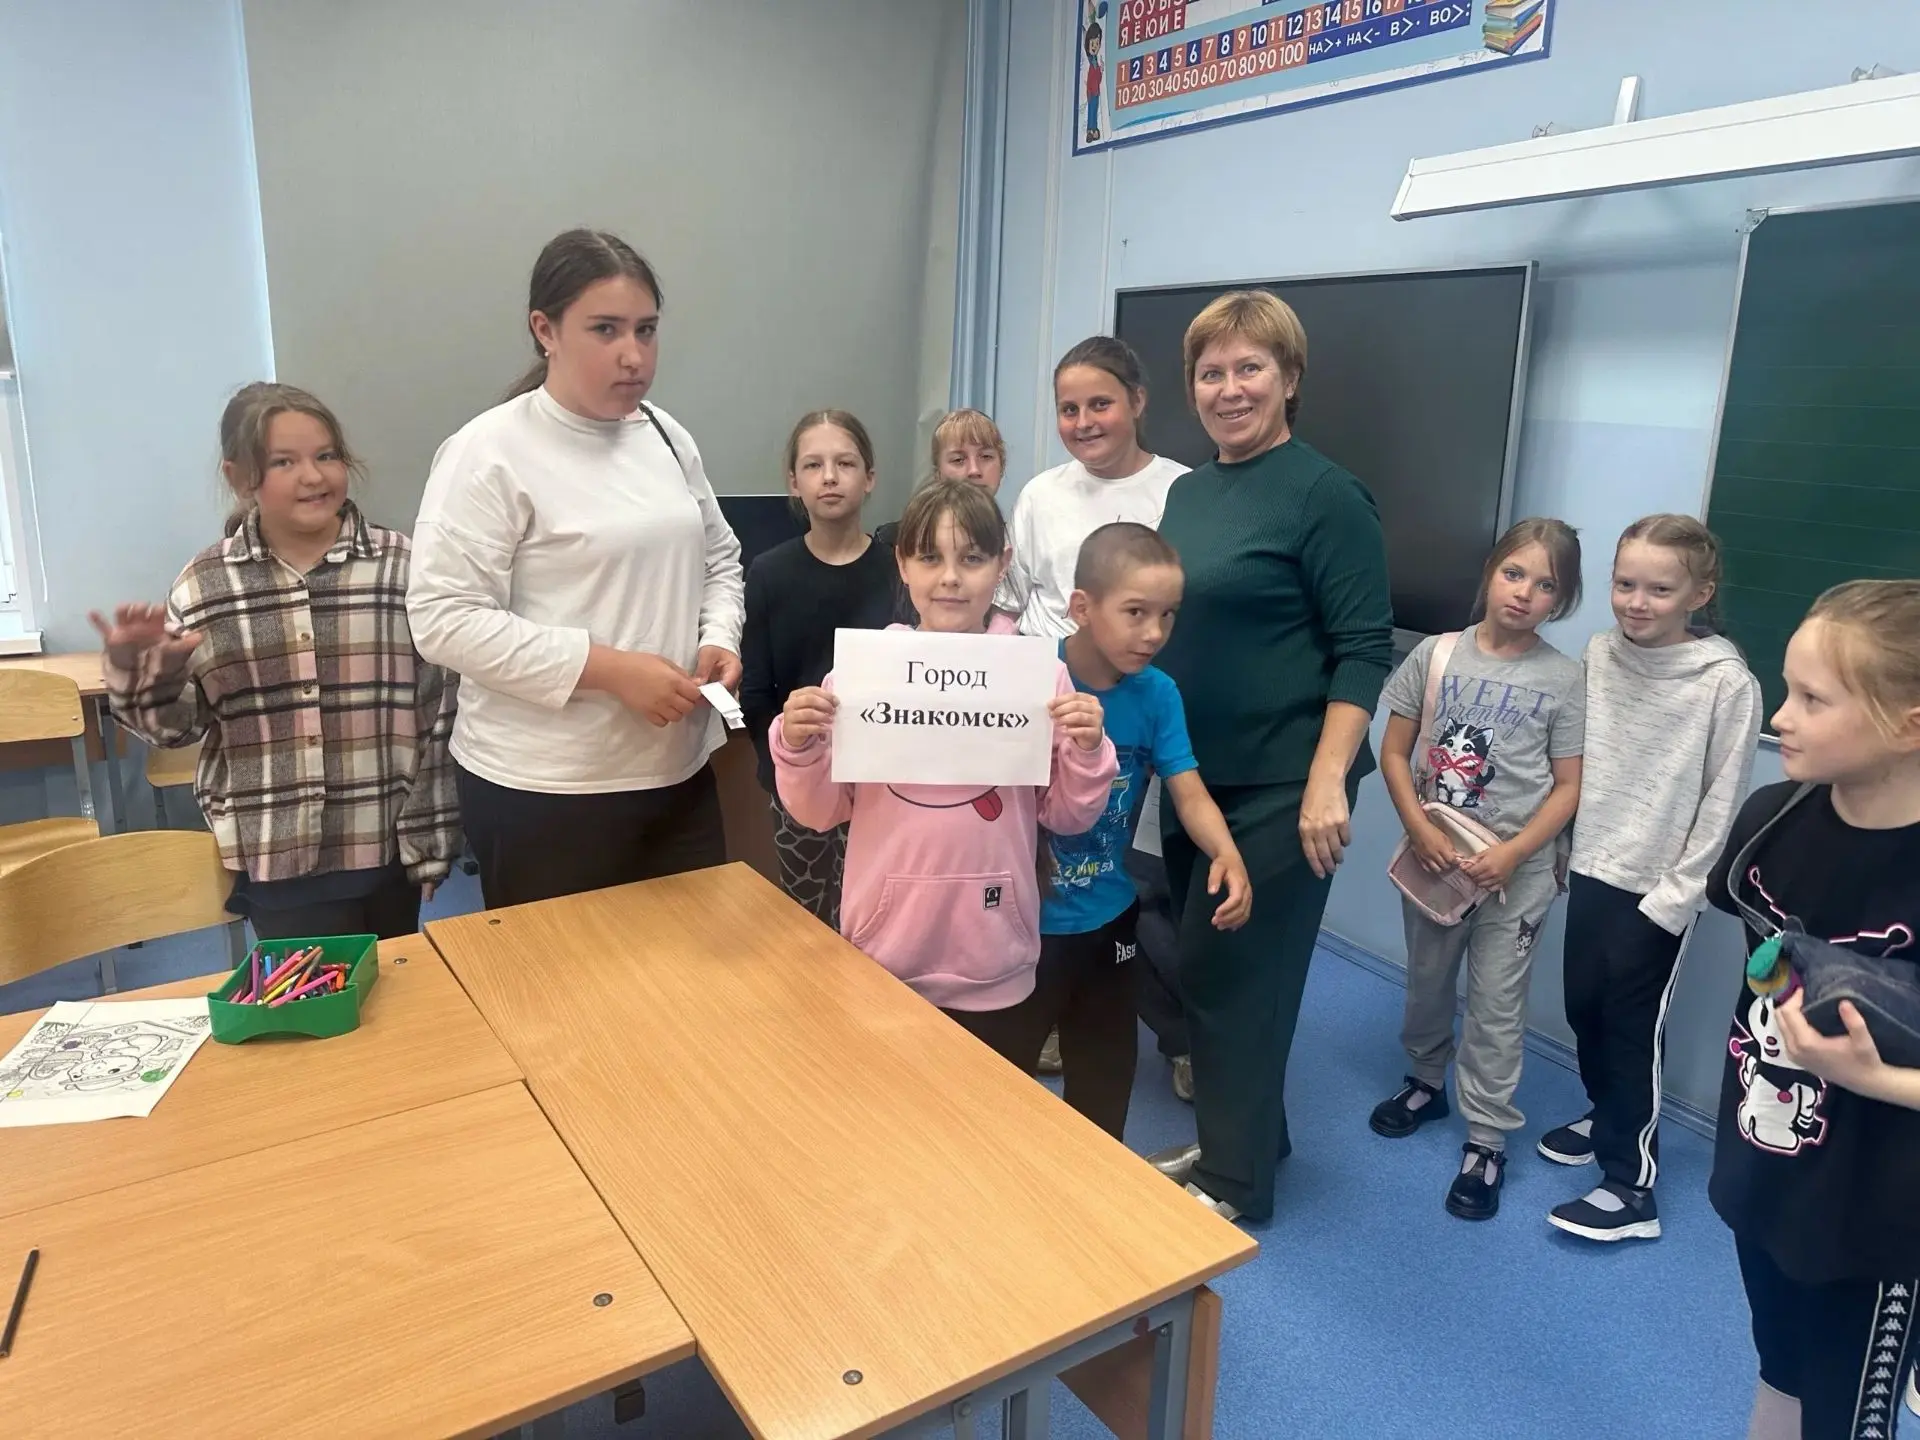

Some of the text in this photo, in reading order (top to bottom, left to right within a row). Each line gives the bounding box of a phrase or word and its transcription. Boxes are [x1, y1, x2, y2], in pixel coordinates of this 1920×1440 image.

[1120, 9, 1182, 47] Я Ё Ю И Е
[1121, 4, 1131, 24] А
[1121, 64, 1126, 82] 1
[1131, 60, 1140, 79] 2
[1146, 56, 1154, 75] 3
[1159, 51, 1167, 71] 4
[1174, 48, 1183, 67] 5
[1189, 44, 1198, 63] 6
[1205, 39, 1214, 59] 7
[1221, 34, 1230, 55] 8
[1238, 30, 1247, 50] 9
[1252, 24, 1267, 46] 10
[1270, 20, 1283, 41] 11
[1287, 14, 1304, 37] 12
[1305, 9, 1322, 32] 13
[1324, 3, 1342, 27] 14
[1344, 0, 1361, 21] 15
[1366, 0, 1382, 16] 16
[1118, 87, 1129, 105] 10
[1131, 83, 1146, 102] 20
[1148, 78, 1164, 98] 30
[1164, 73, 1181, 93] 40
[1182, 69, 1199, 89] 50
[1200, 64, 1218, 85] 60
[1220, 59, 1236, 80] 70
[1239, 54, 1256, 76] 80
[1259, 49, 1277, 71] 90
[1280, 42, 1304, 66] 100
[907, 661, 988, 691] Город
[860, 702, 1029, 728] «Знакомск»
